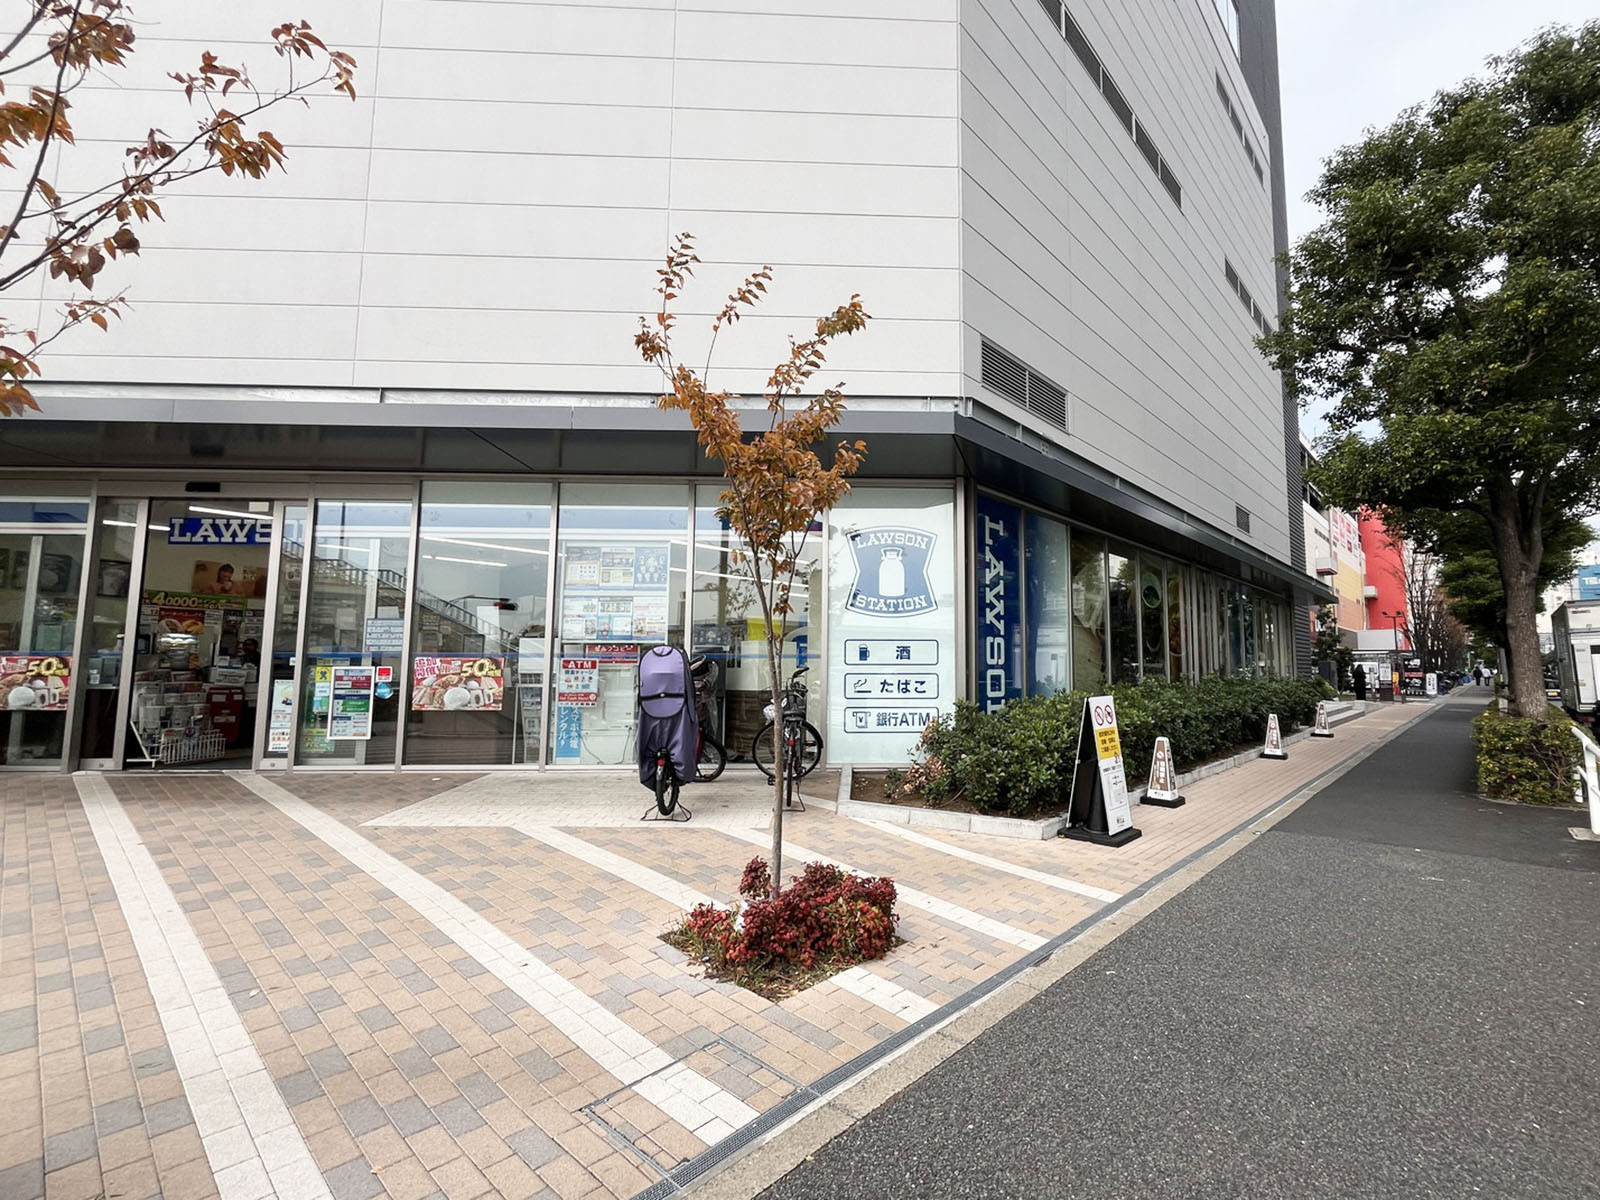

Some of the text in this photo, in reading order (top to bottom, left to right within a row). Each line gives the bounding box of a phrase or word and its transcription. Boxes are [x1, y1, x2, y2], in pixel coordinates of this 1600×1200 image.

[855, 532, 928, 549] LAWSON
[855, 595, 928, 612] STATION
[895, 645, 911, 660] 酒
[568, 660, 592, 669] ATM
[880, 679, 926, 694] たばこ
[876, 712, 931, 727] 銀行ATM
